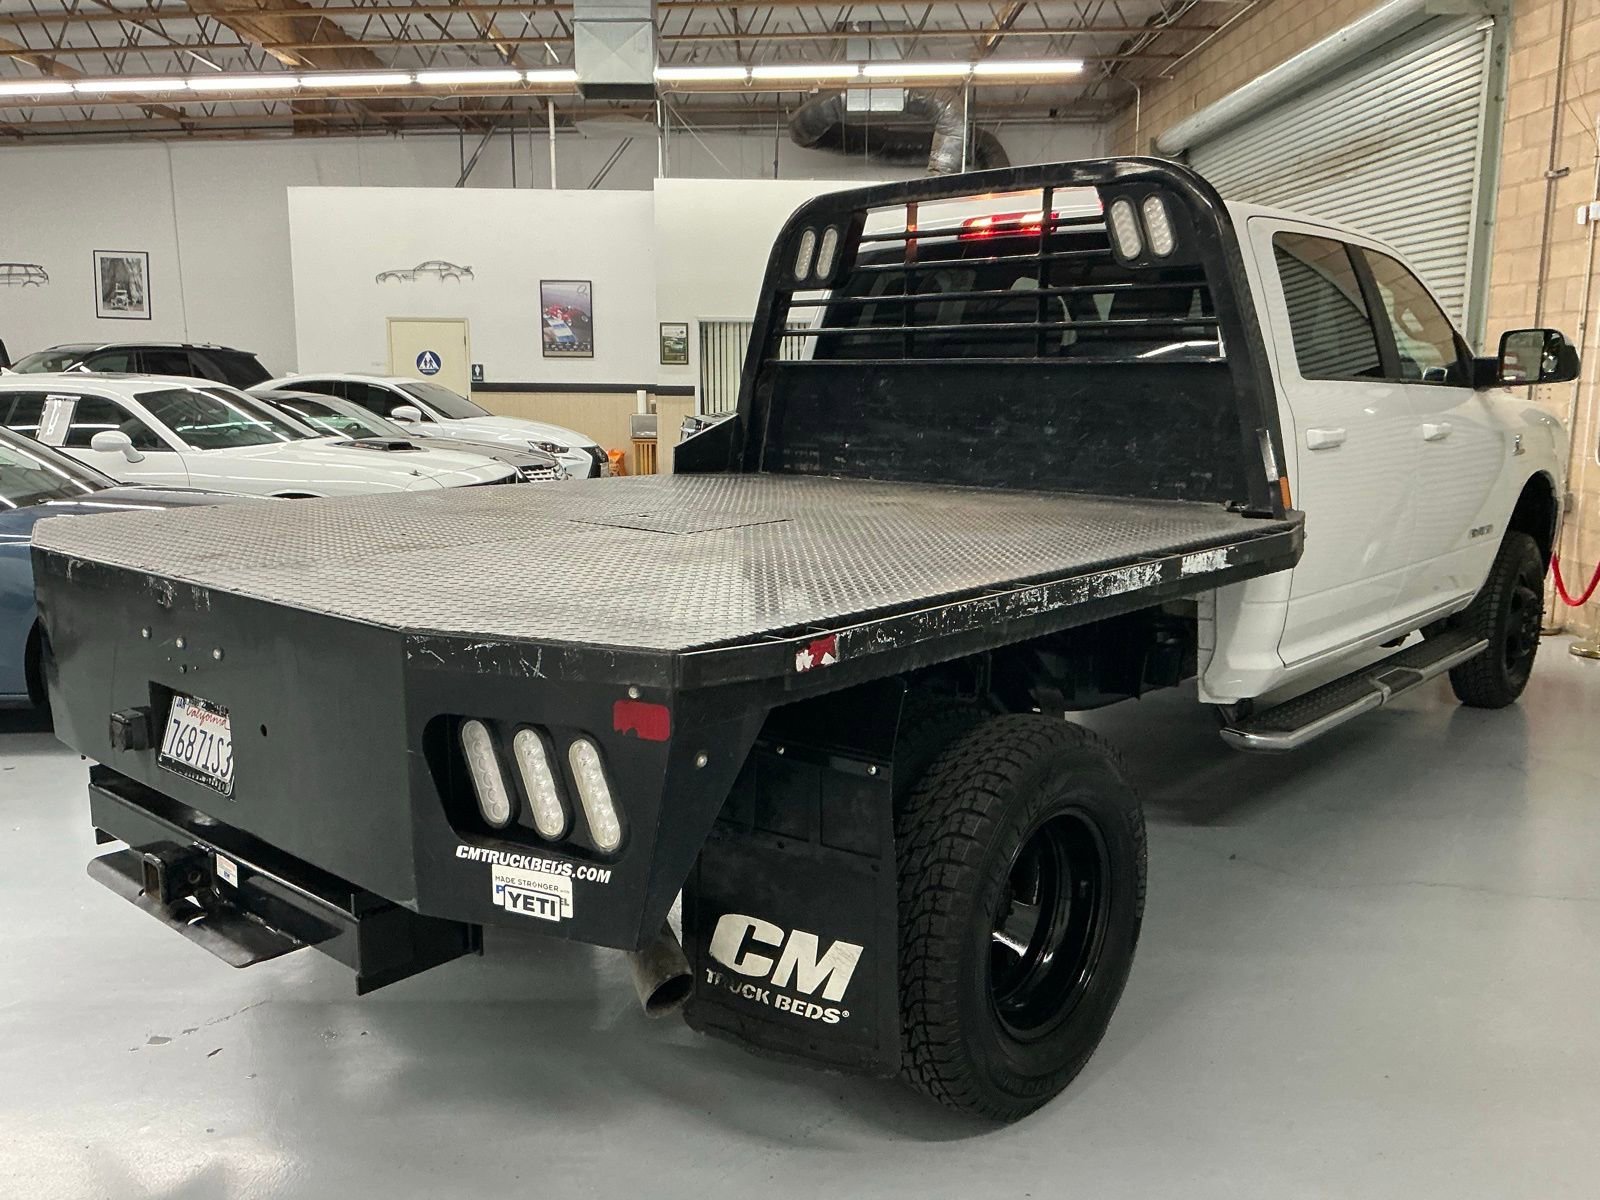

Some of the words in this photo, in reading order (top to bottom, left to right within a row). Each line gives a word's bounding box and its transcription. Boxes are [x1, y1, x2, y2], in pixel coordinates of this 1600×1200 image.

[168, 718, 232, 777] 76871S3
[455, 845, 612, 884] CMTRUCKBEDS.COM
[495, 875, 515, 885] MADE
[517, 878, 559, 892] STRONGER
[508, 891, 556, 917] YETI
[708, 913, 864, 1002] CM
